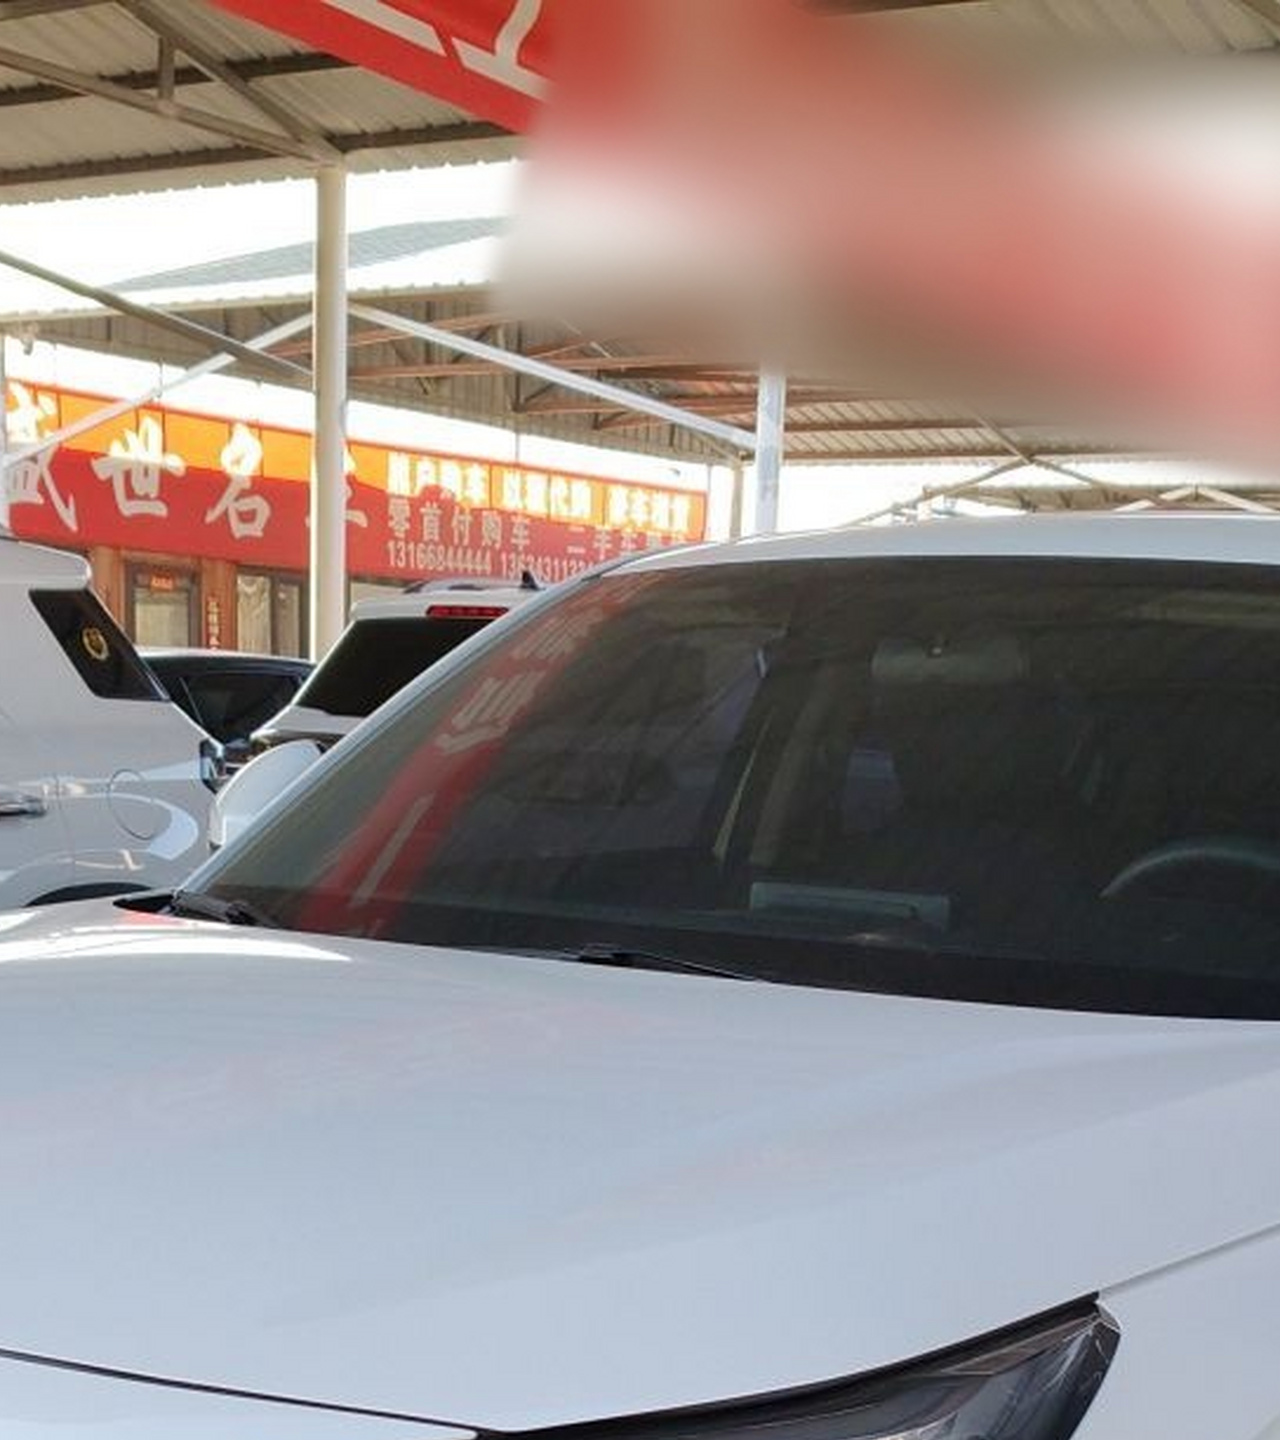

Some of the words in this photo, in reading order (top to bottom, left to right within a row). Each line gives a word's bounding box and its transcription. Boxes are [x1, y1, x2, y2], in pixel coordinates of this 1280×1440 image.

[7, 381, 368, 539] 盛世名
[387, 497, 531, 551] 零首付购车
